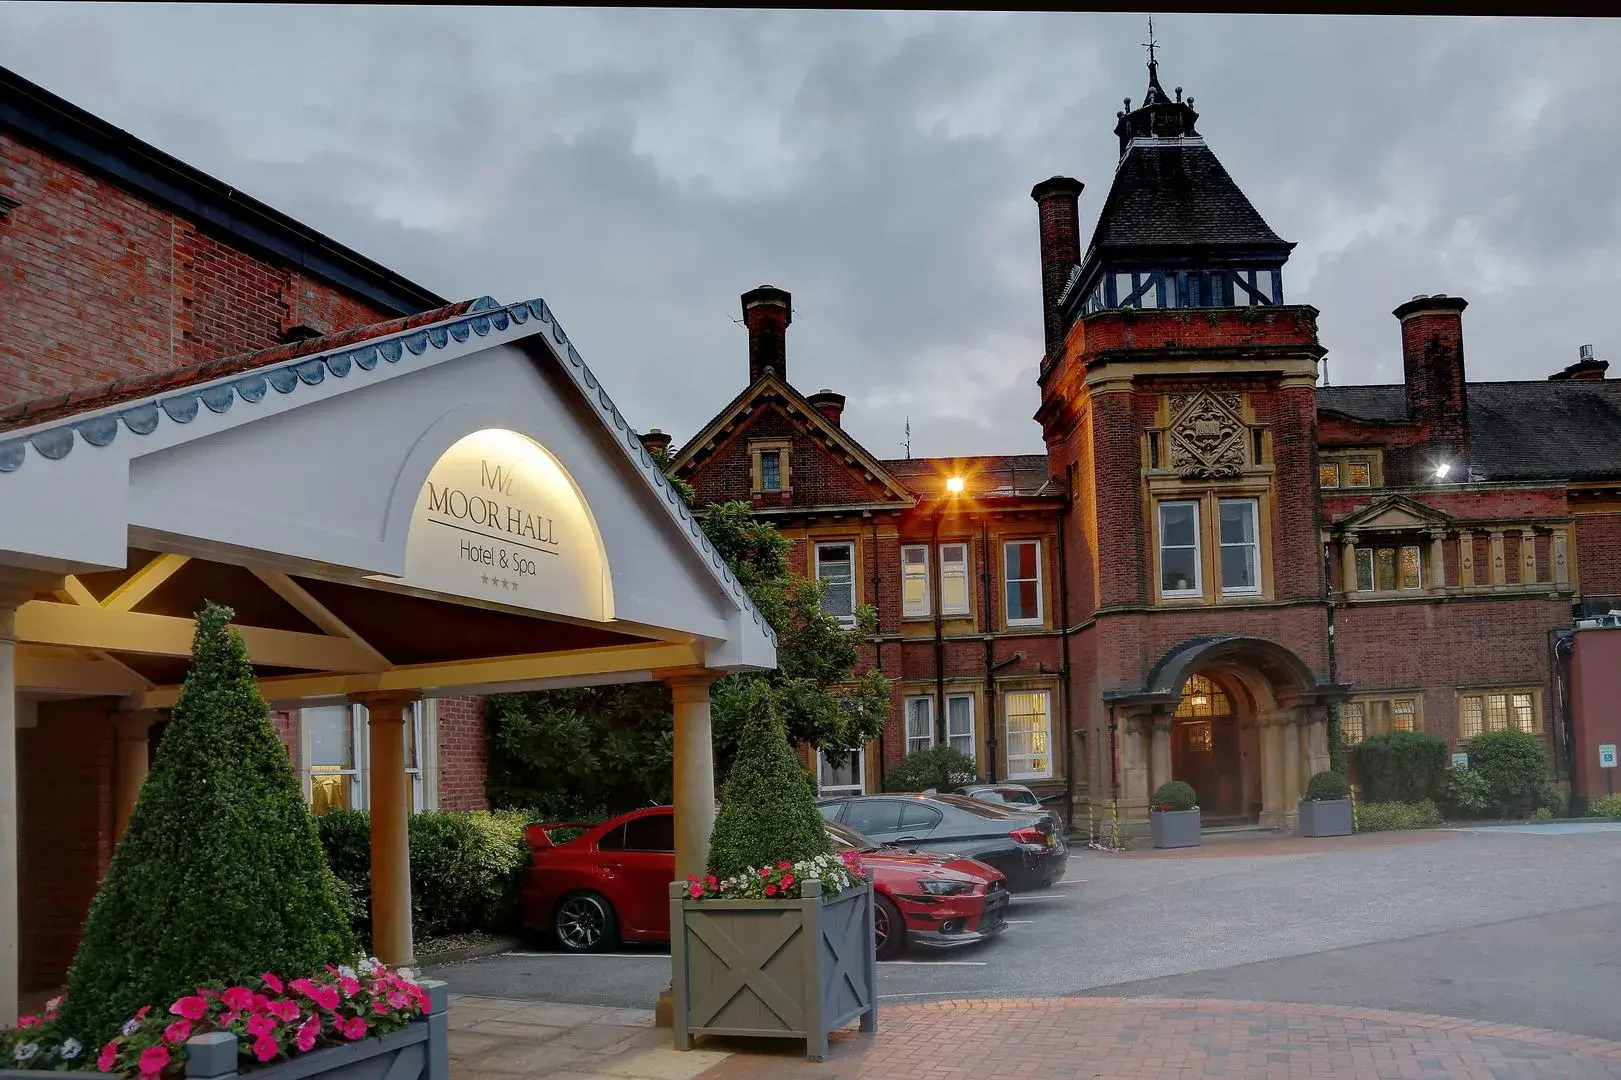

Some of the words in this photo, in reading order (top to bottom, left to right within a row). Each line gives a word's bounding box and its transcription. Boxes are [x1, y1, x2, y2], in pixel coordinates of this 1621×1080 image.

[427, 481, 502, 530] MOOR
[506, 505, 559, 545] HALL
[460, 538, 495, 566] Hotel
[499, 549, 509, 569] &
[513, 552, 537, 577] Spa
